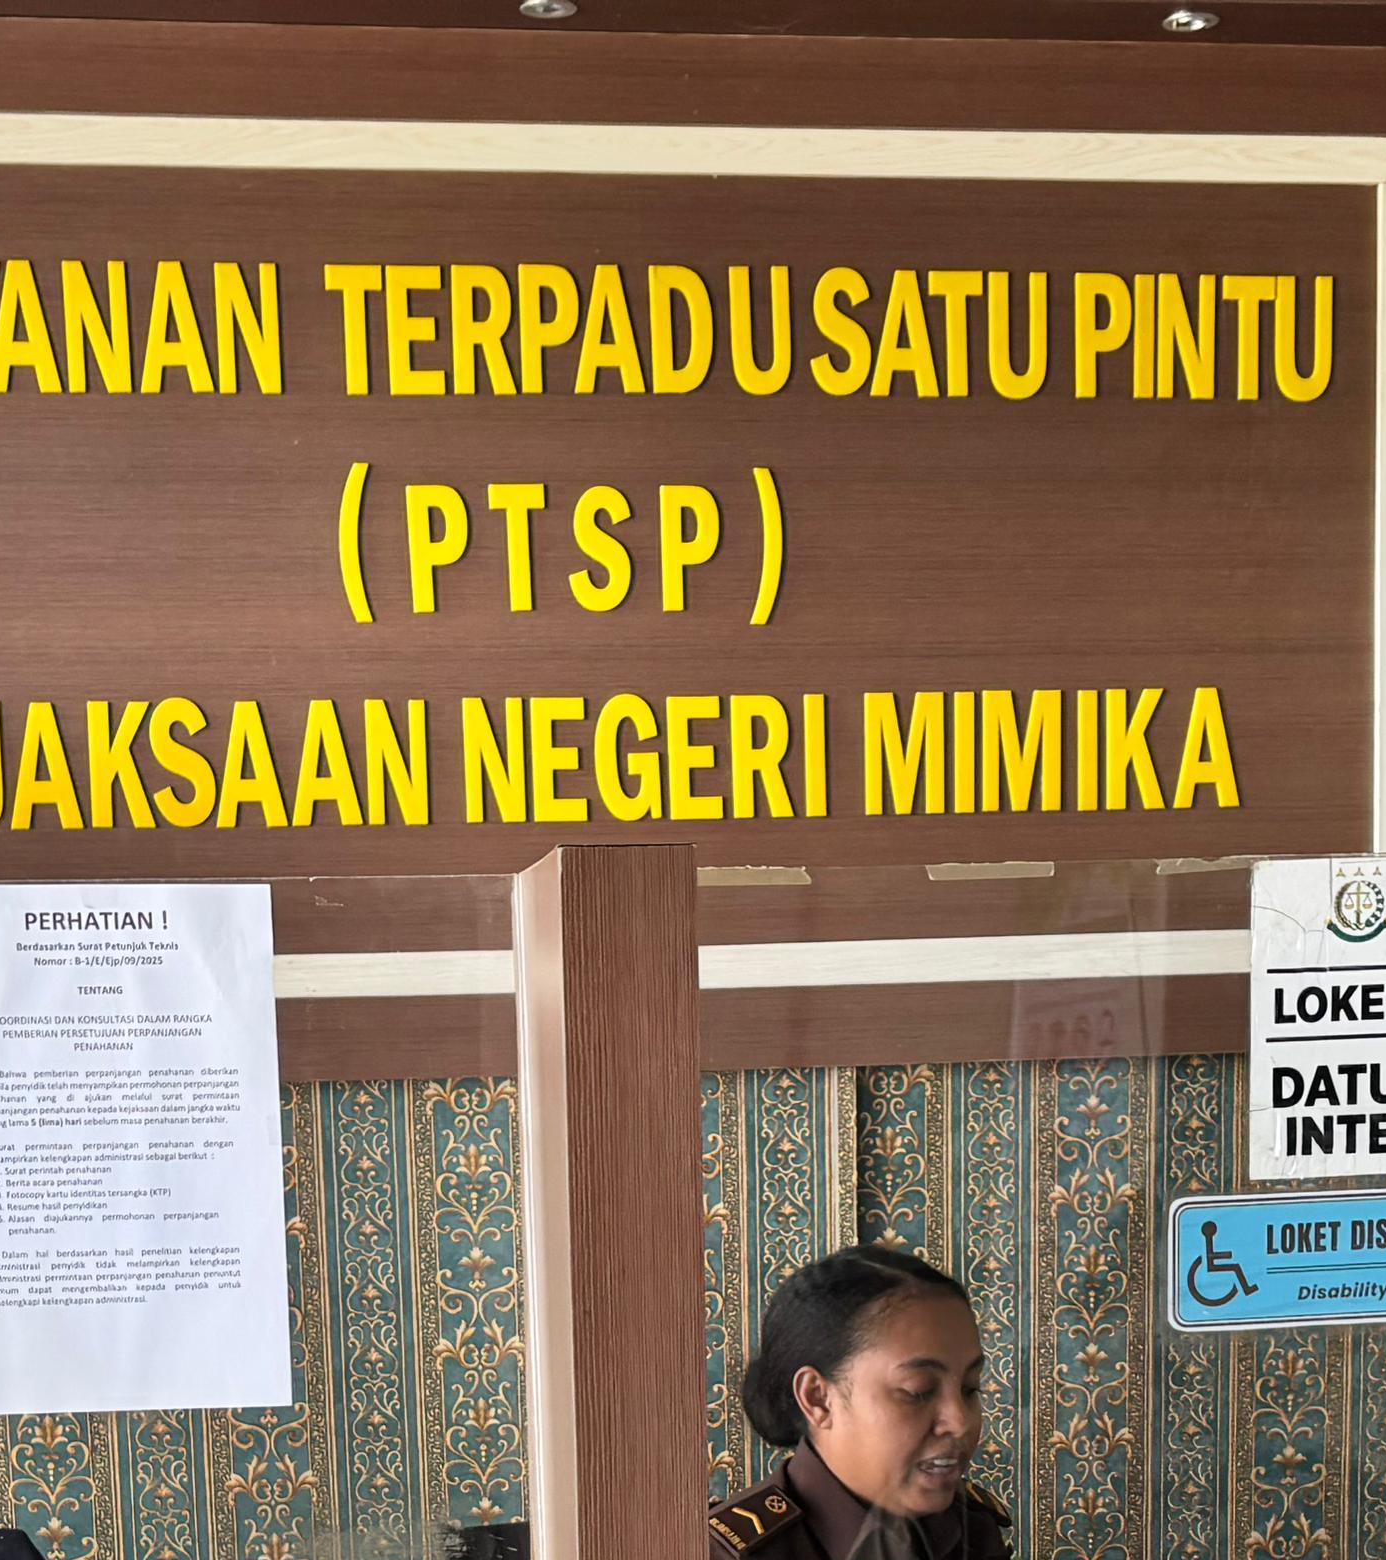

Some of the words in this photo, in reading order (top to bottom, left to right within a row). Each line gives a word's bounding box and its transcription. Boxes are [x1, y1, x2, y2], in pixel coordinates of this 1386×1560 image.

[324, 263, 792, 395] TERPADU
[809, 267, 1048, 400] SATU
[1074, 271, 1333, 402] PINTU
[461, 692, 828, 823] NEGERI
[863, 687, 1241, 816] MIMIKA
[23, 911, 153, 929] PERHATIAN
[161, 909, 168, 929] !
[15, 942, 75, 951] Berdasarkan
[76, 942, 103, 950] Surat
[103, 942, 148, 952] Petunjuk
[148, 942, 178, 950] Teknis
[33, 956, 67, 965] Nomor
[76, 985, 123, 994] TENTANG
[53, 1015, 75, 1024] DAN
[76, 1014, 134, 1024] KONSULTASI
[136, 1014, 171, 1023] DALAM
[172, 1014, 212, 1023] RANGKA
[2, 1028, 58, 1038] PEMBERIAN
[59, 1028, 125, 1037] PERSETUJUAN
[126, 1027, 202, 1036] PERPANJANGAN
[73, 1041, 133, 1050] PENAHANAN
[1266, 1219, 1341, 1255] LOKET
